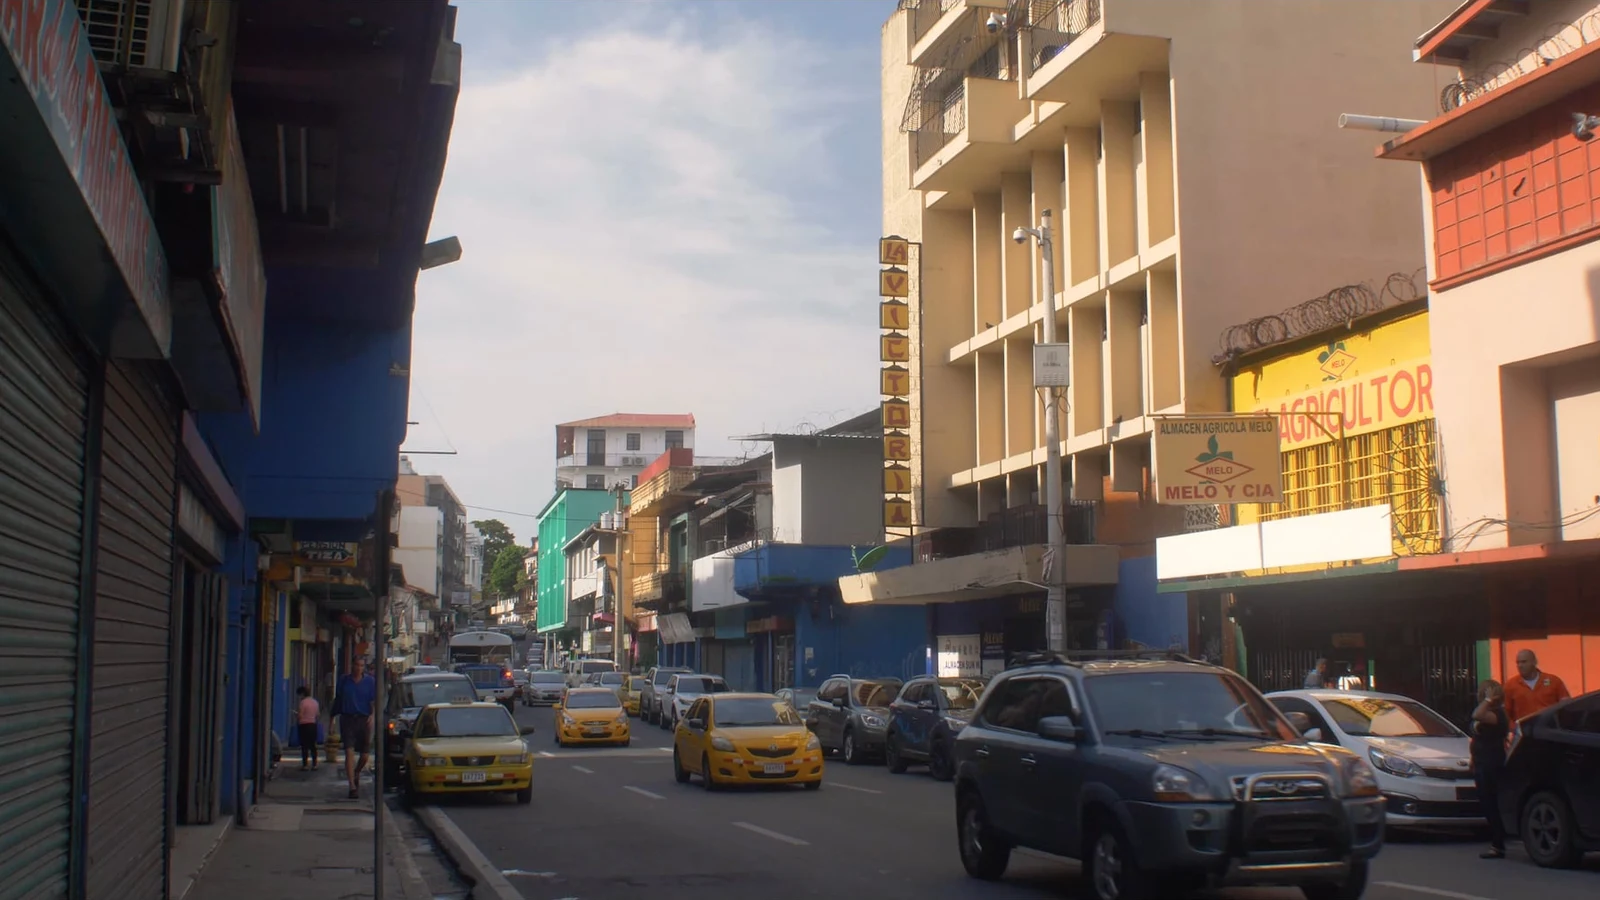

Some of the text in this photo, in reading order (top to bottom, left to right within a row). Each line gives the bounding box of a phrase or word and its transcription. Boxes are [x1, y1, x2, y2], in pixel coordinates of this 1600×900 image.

[1331, 359, 1345, 369] MELO
[886, 242, 908, 524] LA VICTORIA
[1279, 363, 1434, 444] AGRICULTOR
[1160, 420, 1273, 435] ALMACEN AGRICOLA MELO
[1205, 466, 1233, 475] MELO
[1165, 483, 1275, 500] MELO Y CIA
